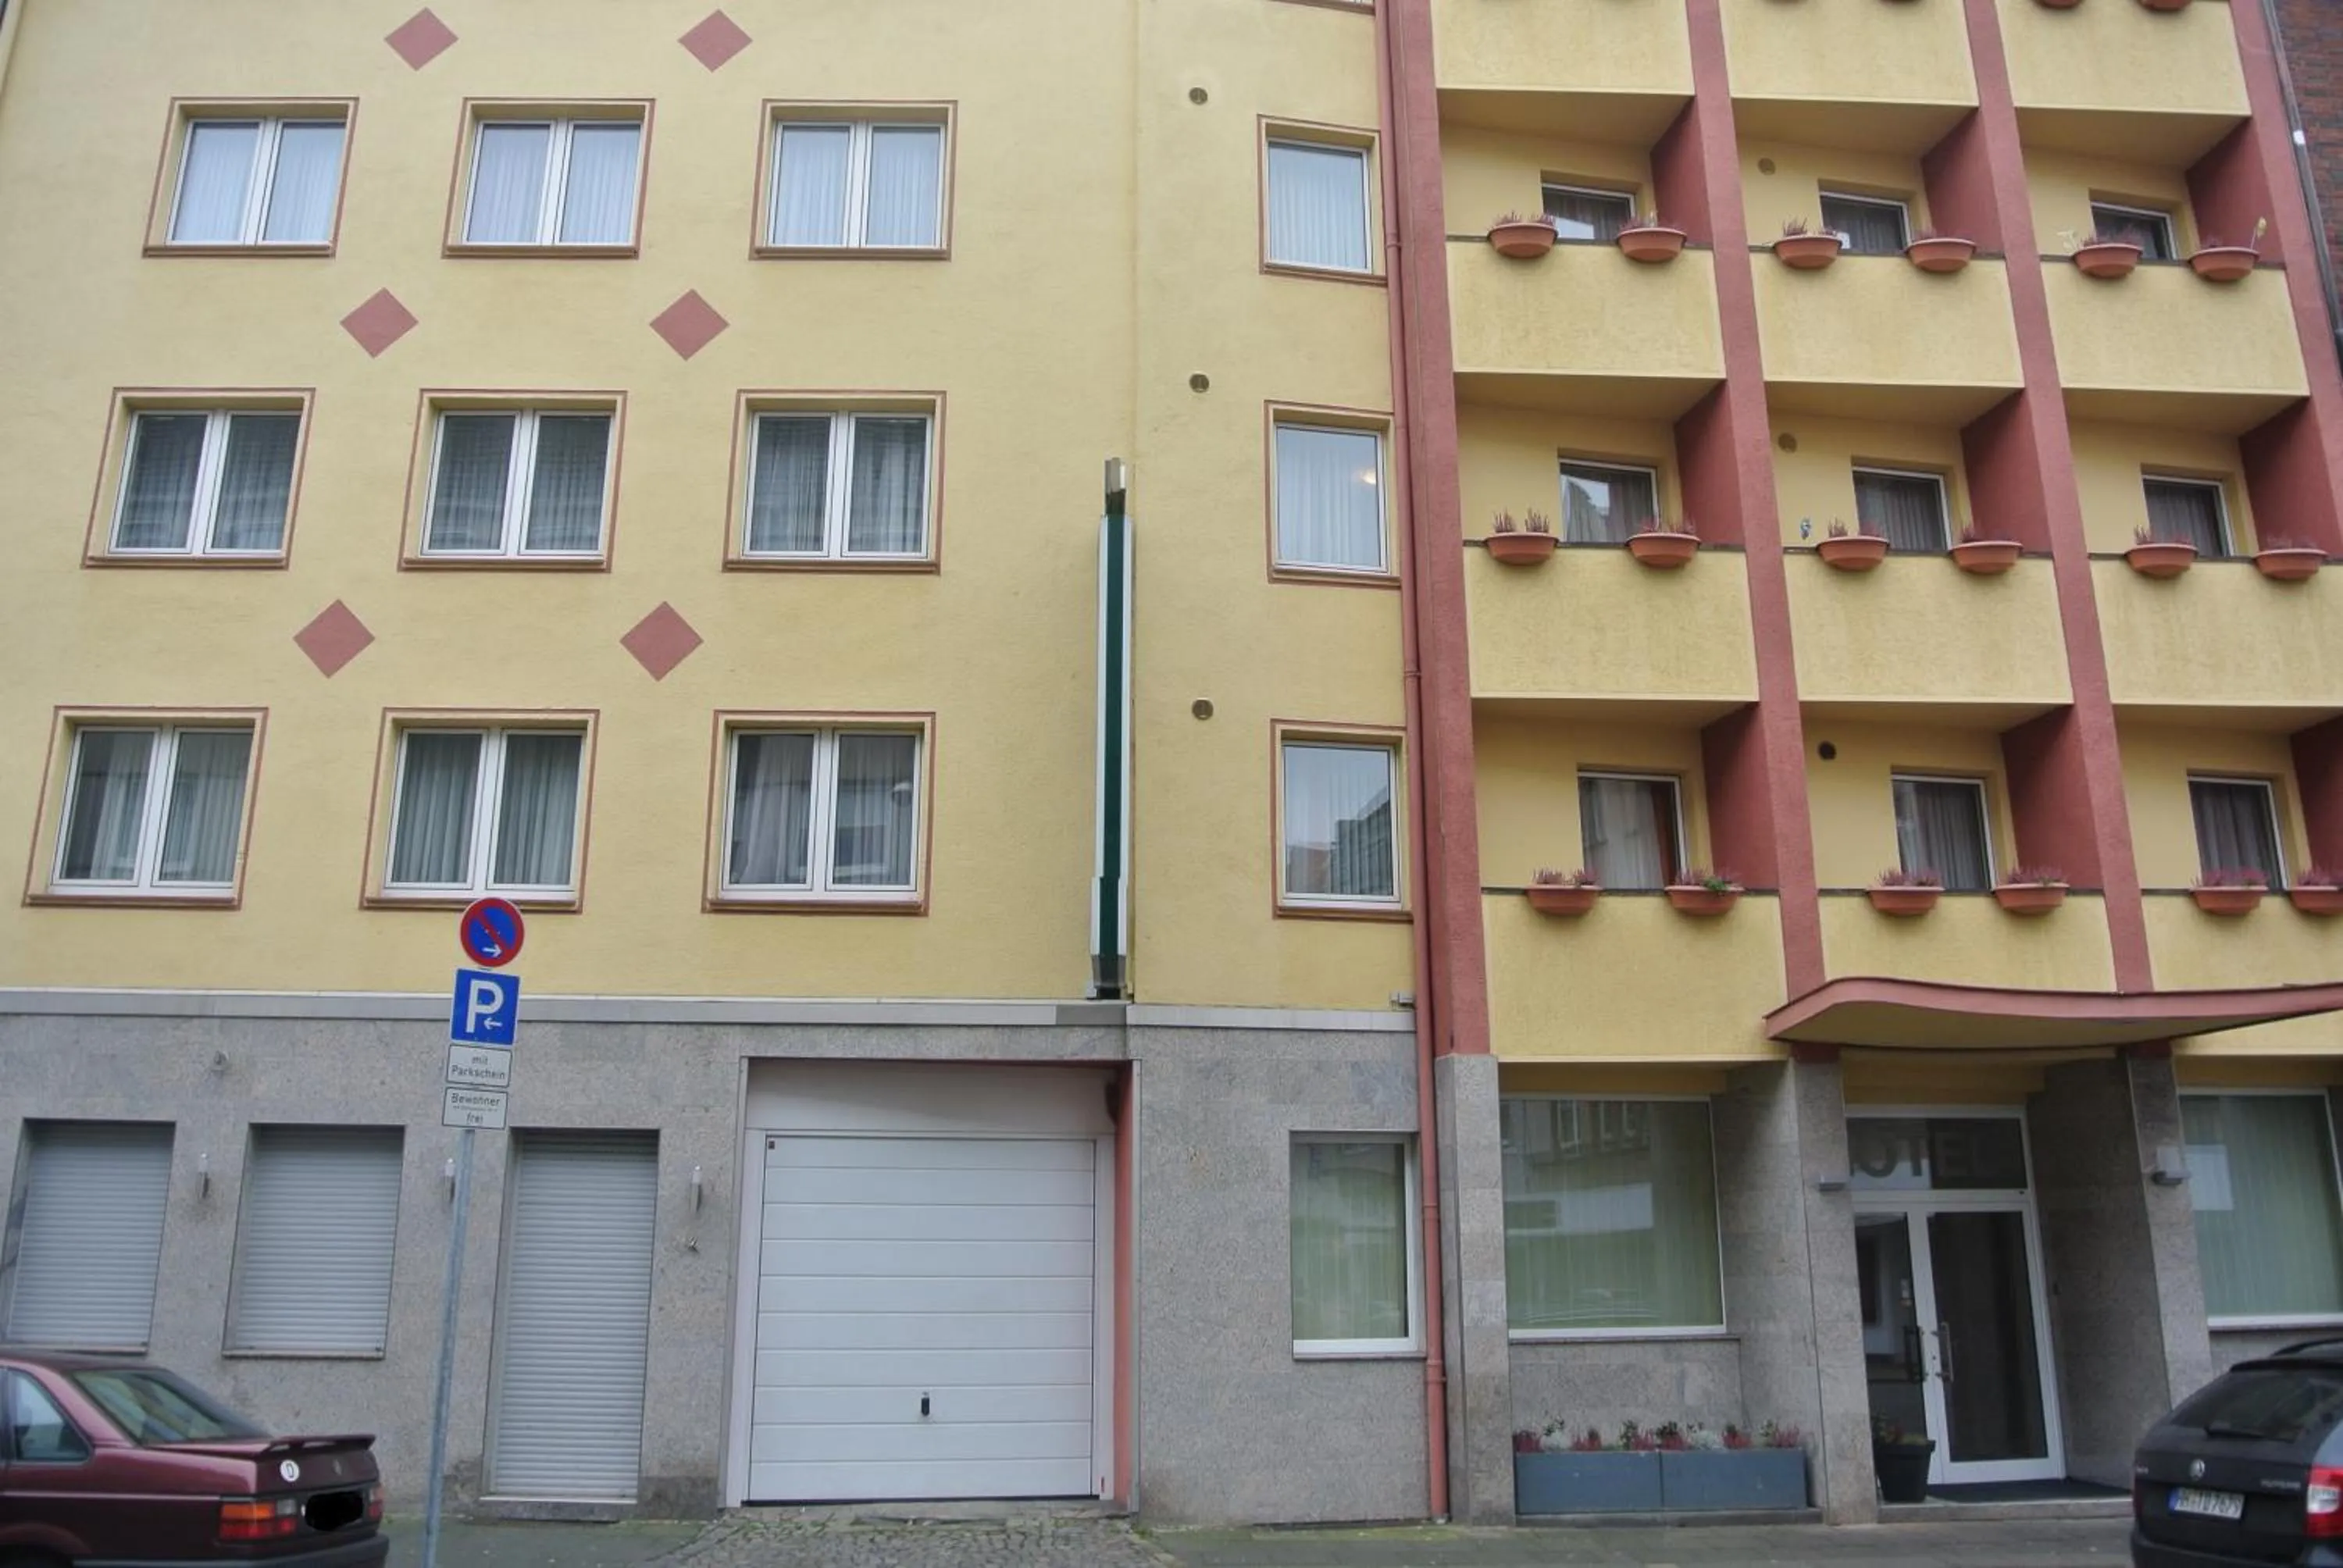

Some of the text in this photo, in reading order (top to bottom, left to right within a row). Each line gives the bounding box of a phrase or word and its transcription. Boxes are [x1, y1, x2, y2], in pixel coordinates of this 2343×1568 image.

[465, 978, 505, 1033] P
[472, 1054, 489, 1064] mit
[451, 1065, 505, 1080] Parkschein
[451, 1092, 501, 1107] Bewohner
[466, 1112, 483, 1124] frei
